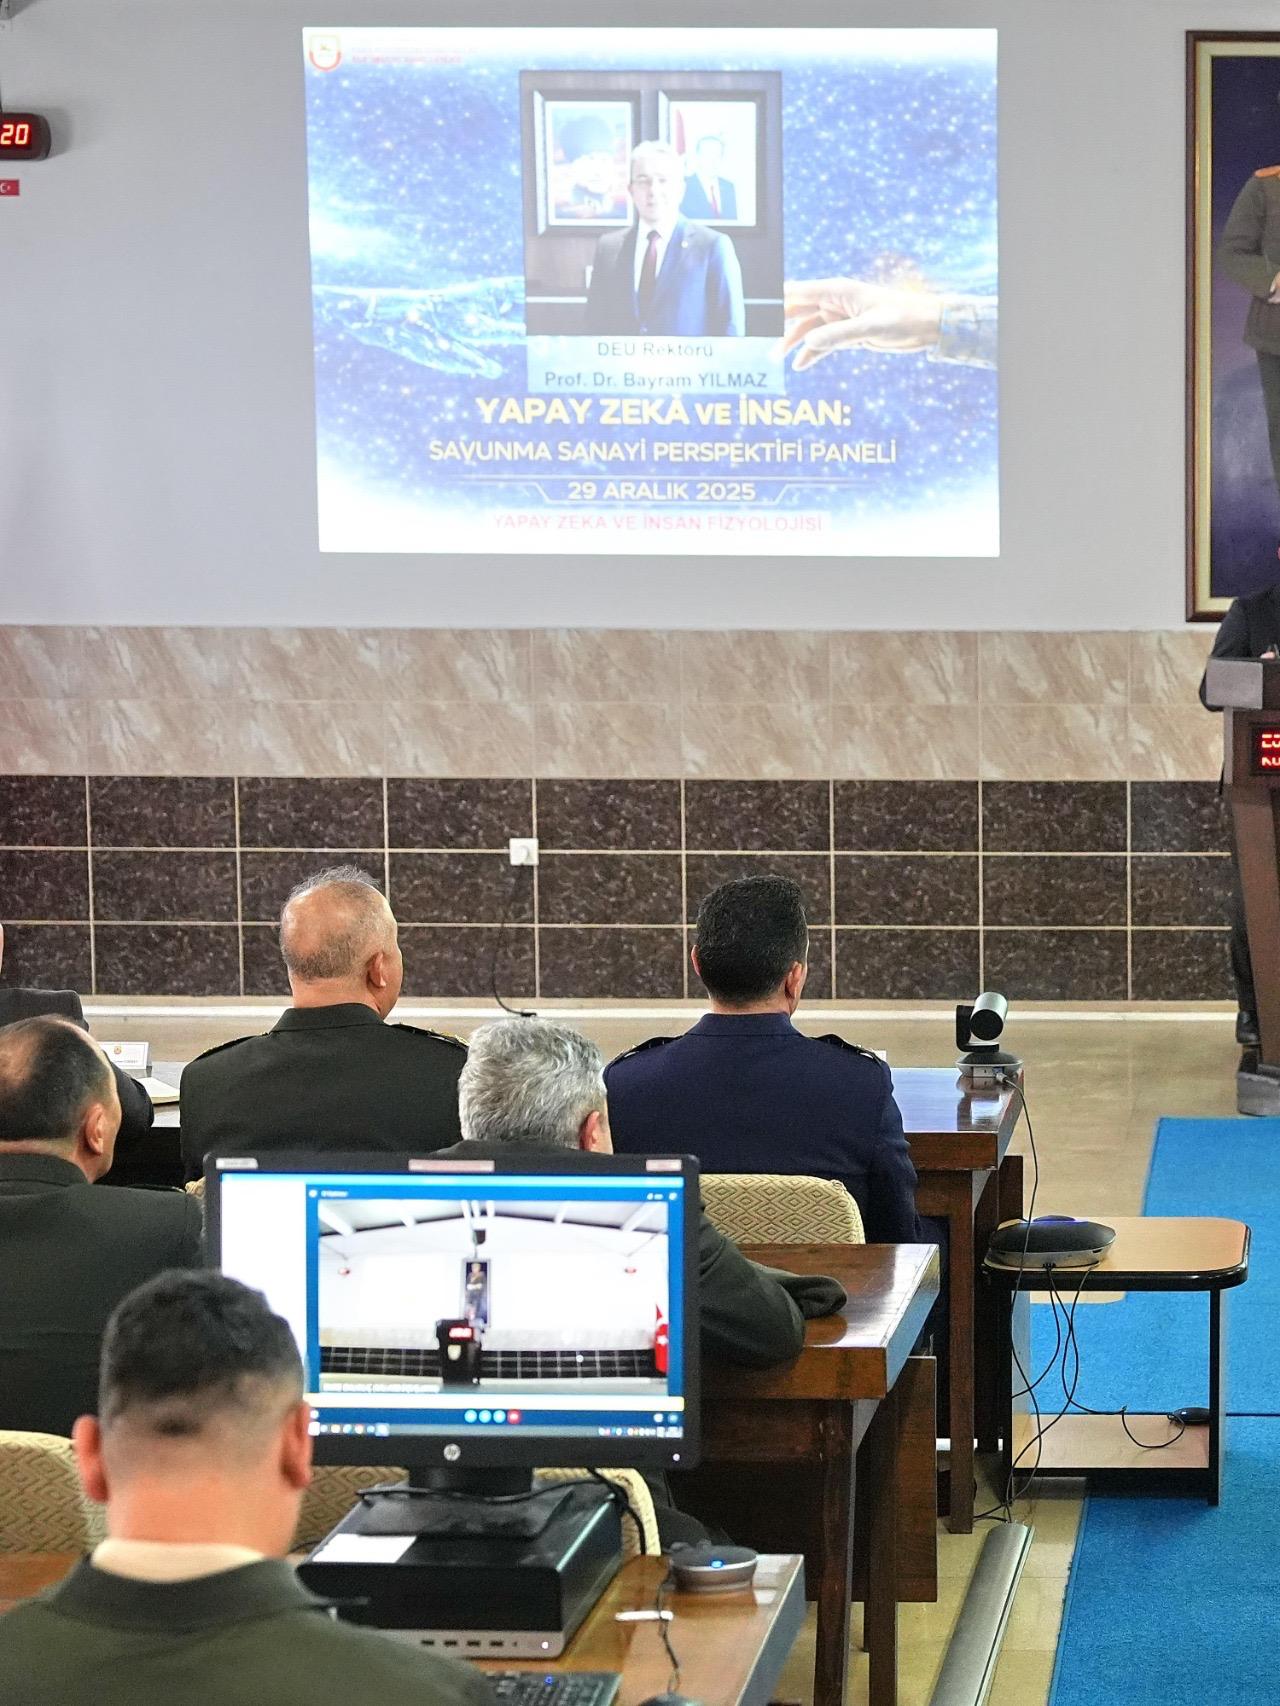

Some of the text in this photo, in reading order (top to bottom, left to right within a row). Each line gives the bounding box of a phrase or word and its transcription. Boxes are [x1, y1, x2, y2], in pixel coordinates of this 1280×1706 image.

[545, 372, 768, 391] Prof. Dr. Bayram YILMAZ
[475, 397, 592, 424] YAPAY
[739, 393, 851, 426] İNSAN:
[429, 438, 897, 463] SAVUNMA SANAYİ PERSPEKTİFİ PANELİ
[567, 482, 757, 501] 29 ARALIK 2025
[494, 515, 549, 529] YAPAY
[613, 515, 637, 530] VE
[643, 513, 701, 531] İNSAN
